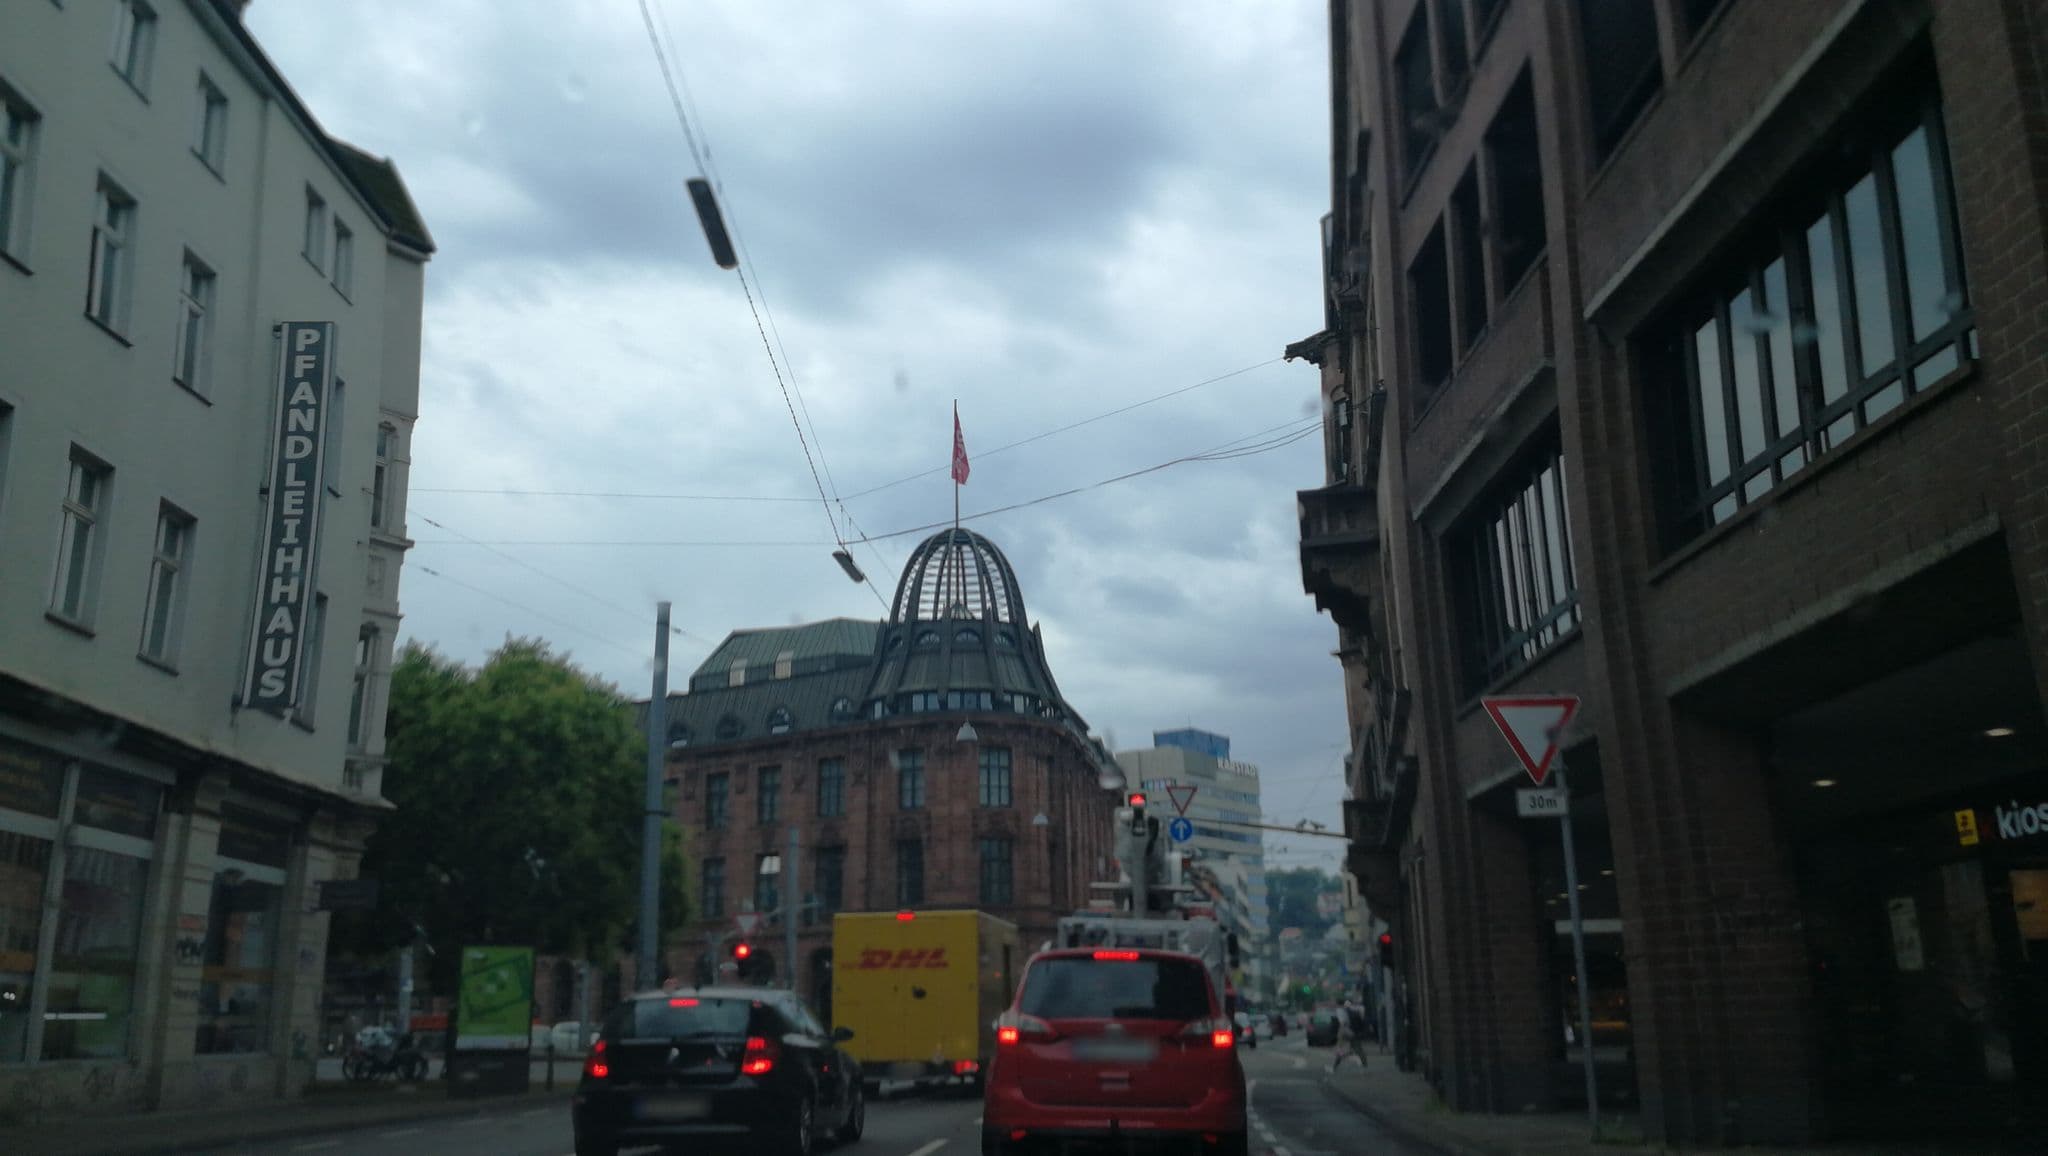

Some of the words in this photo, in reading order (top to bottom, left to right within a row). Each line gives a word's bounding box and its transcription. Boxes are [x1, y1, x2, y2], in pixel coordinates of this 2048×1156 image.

[258, 328, 321, 698] PFANDLEIHHAUS
[1528, 795, 1558, 809] 30m
[858, 947, 950, 969] DHL
